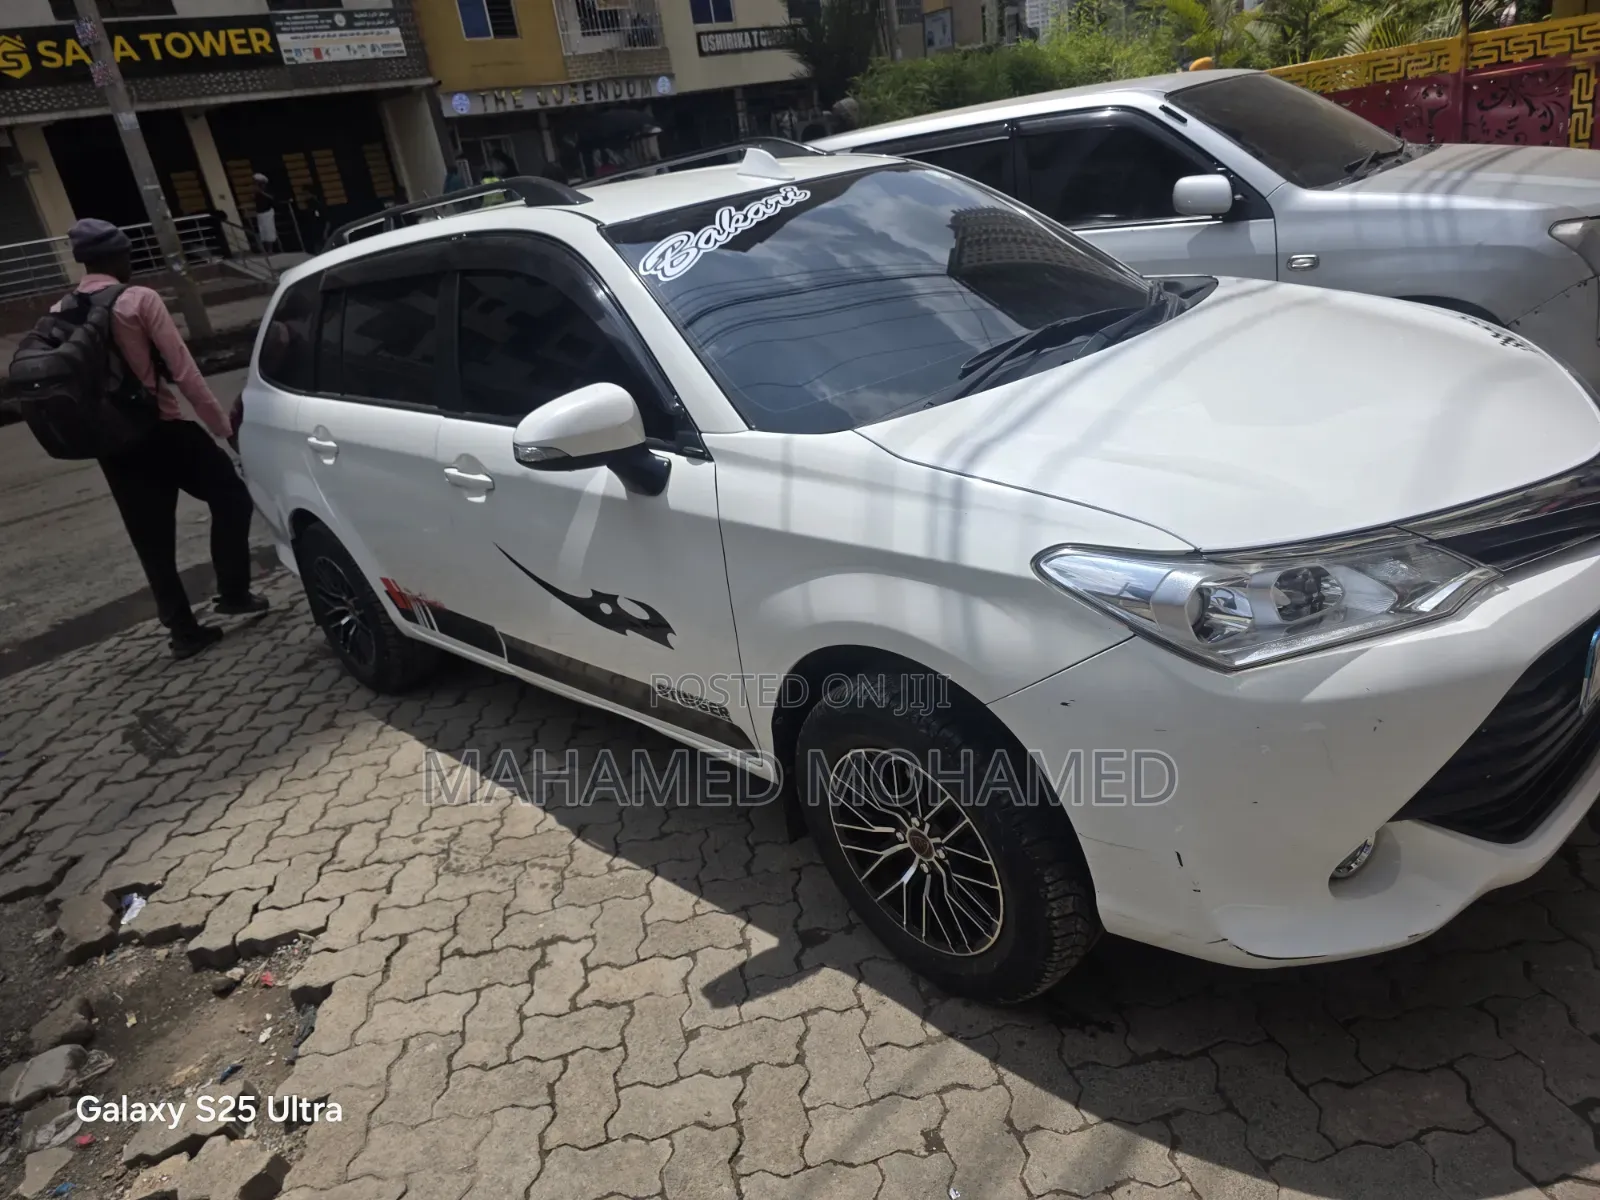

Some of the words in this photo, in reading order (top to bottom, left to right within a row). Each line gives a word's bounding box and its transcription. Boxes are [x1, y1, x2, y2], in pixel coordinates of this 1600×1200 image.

[37, 35, 141, 69] SAA
[139, 27, 274, 61] TOWER
[700, 31, 752, 53] USHIRIKA
[478, 88, 524, 112] THE
[638, 185, 811, 282] Bakari
